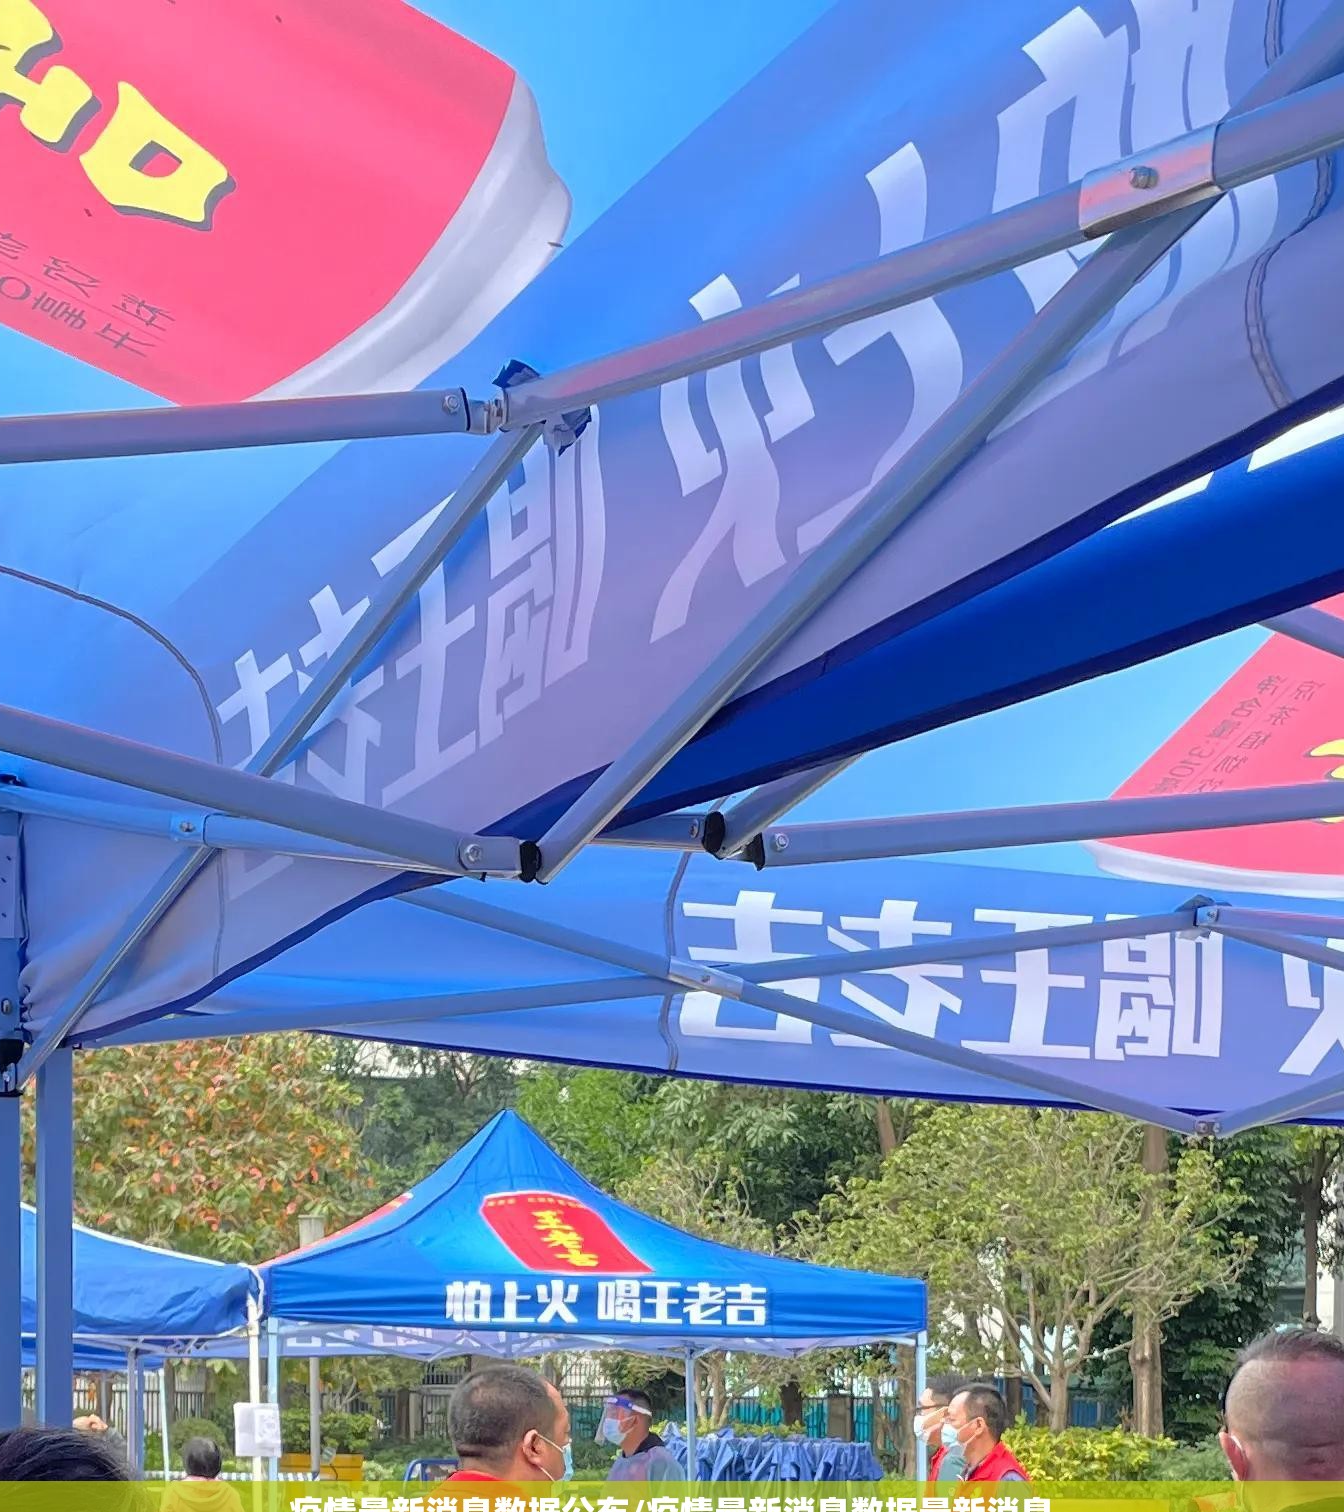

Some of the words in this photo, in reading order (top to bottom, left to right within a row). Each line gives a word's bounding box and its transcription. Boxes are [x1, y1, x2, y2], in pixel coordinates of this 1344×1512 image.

[445, 1279, 579, 1325] 怕上火
[597, 1280, 767, 1327] 喝王老吉
